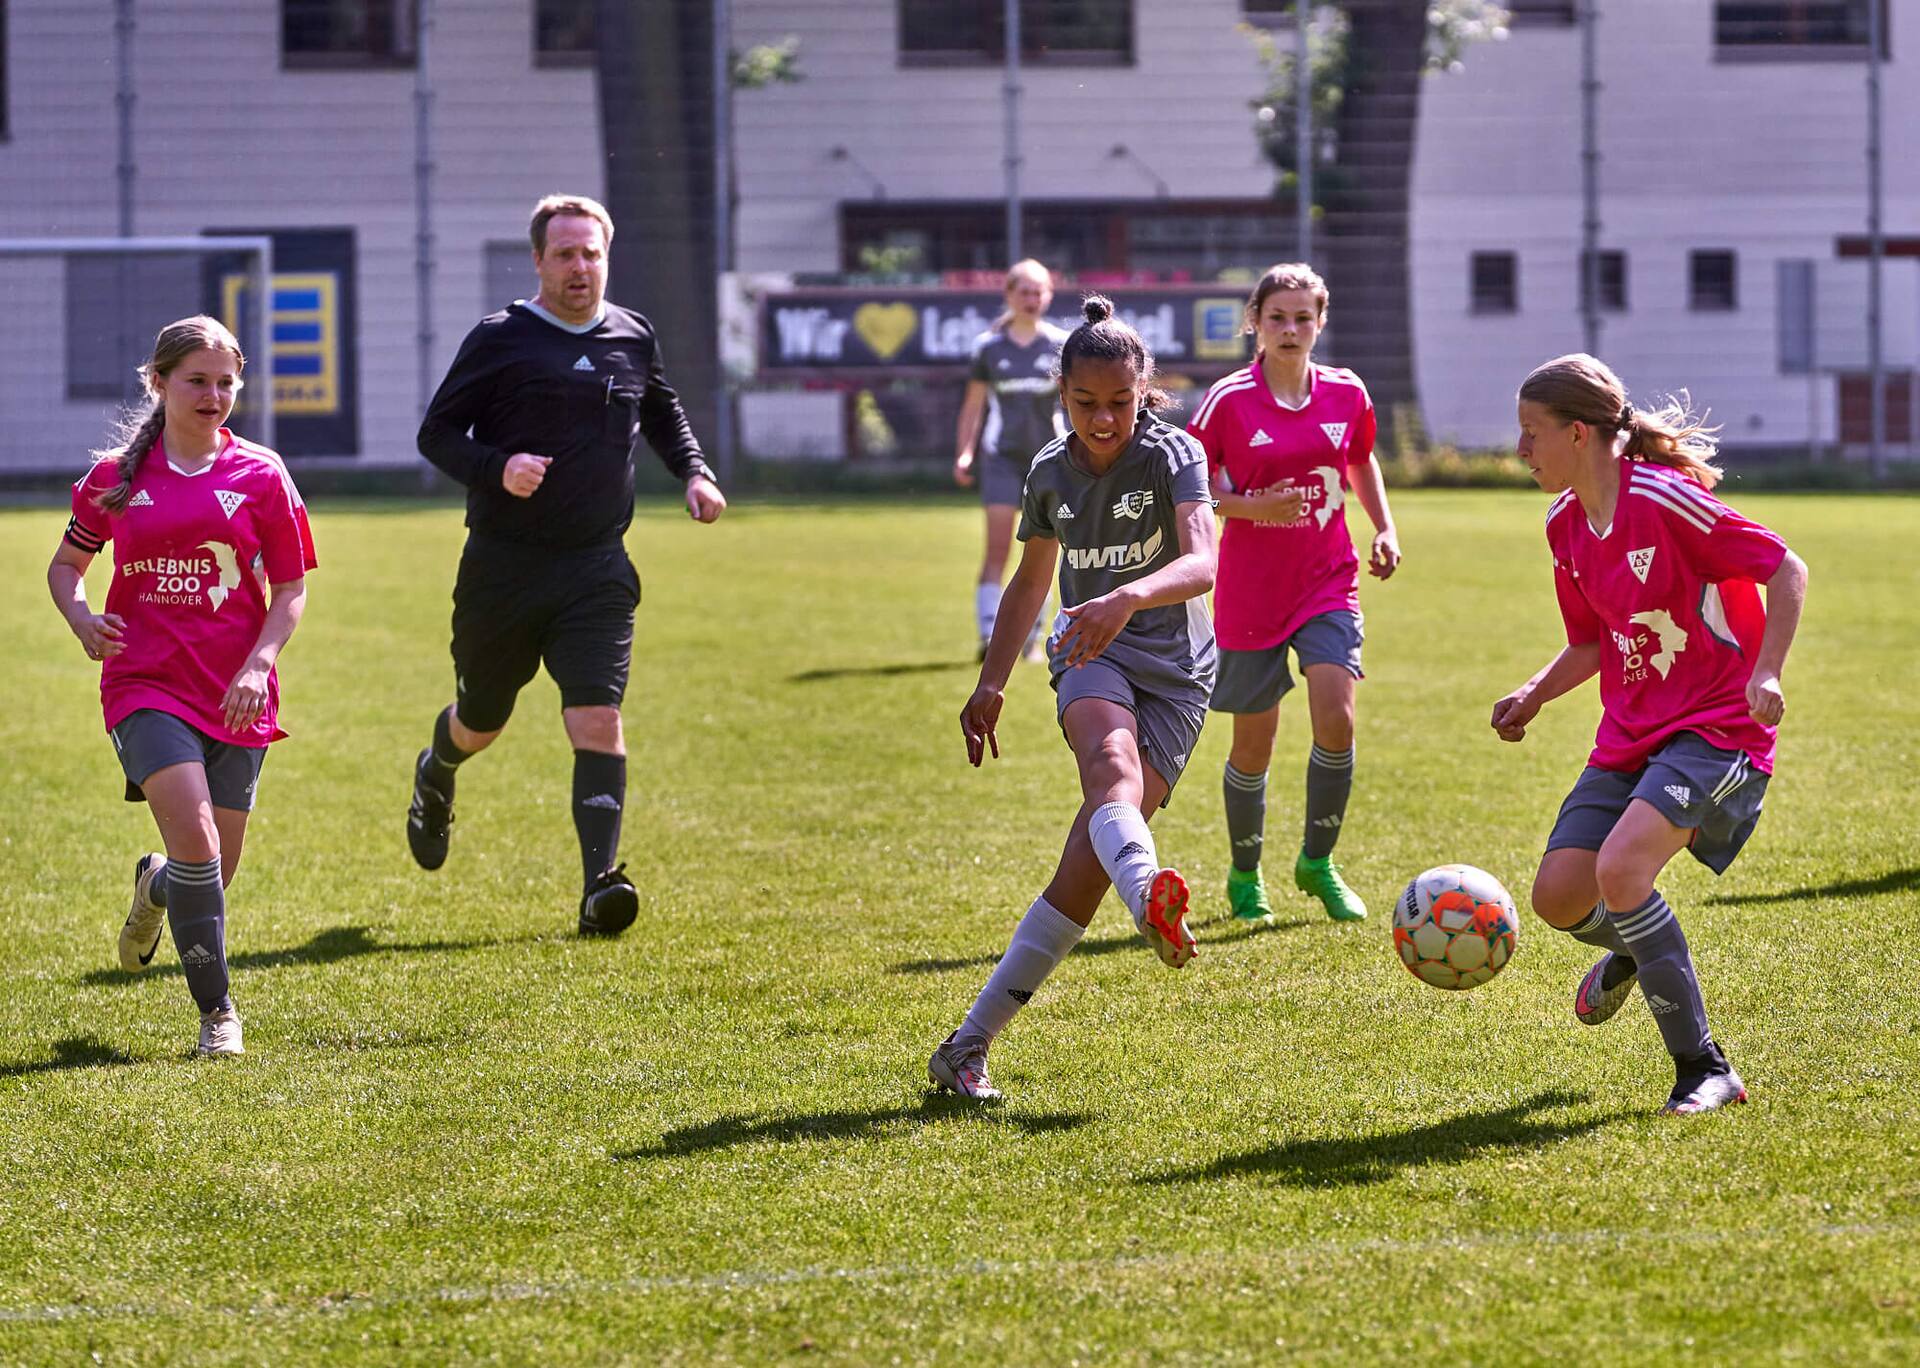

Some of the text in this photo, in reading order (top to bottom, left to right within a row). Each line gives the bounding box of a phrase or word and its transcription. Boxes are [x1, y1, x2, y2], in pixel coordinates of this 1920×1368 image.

[776, 306, 848, 359] Wir
[1206, 307, 1233, 341] E
[122, 557, 212, 577] ERLEBNIS
[156, 576, 200, 593] ZOO
[138, 592, 203, 605] HANNOVER
